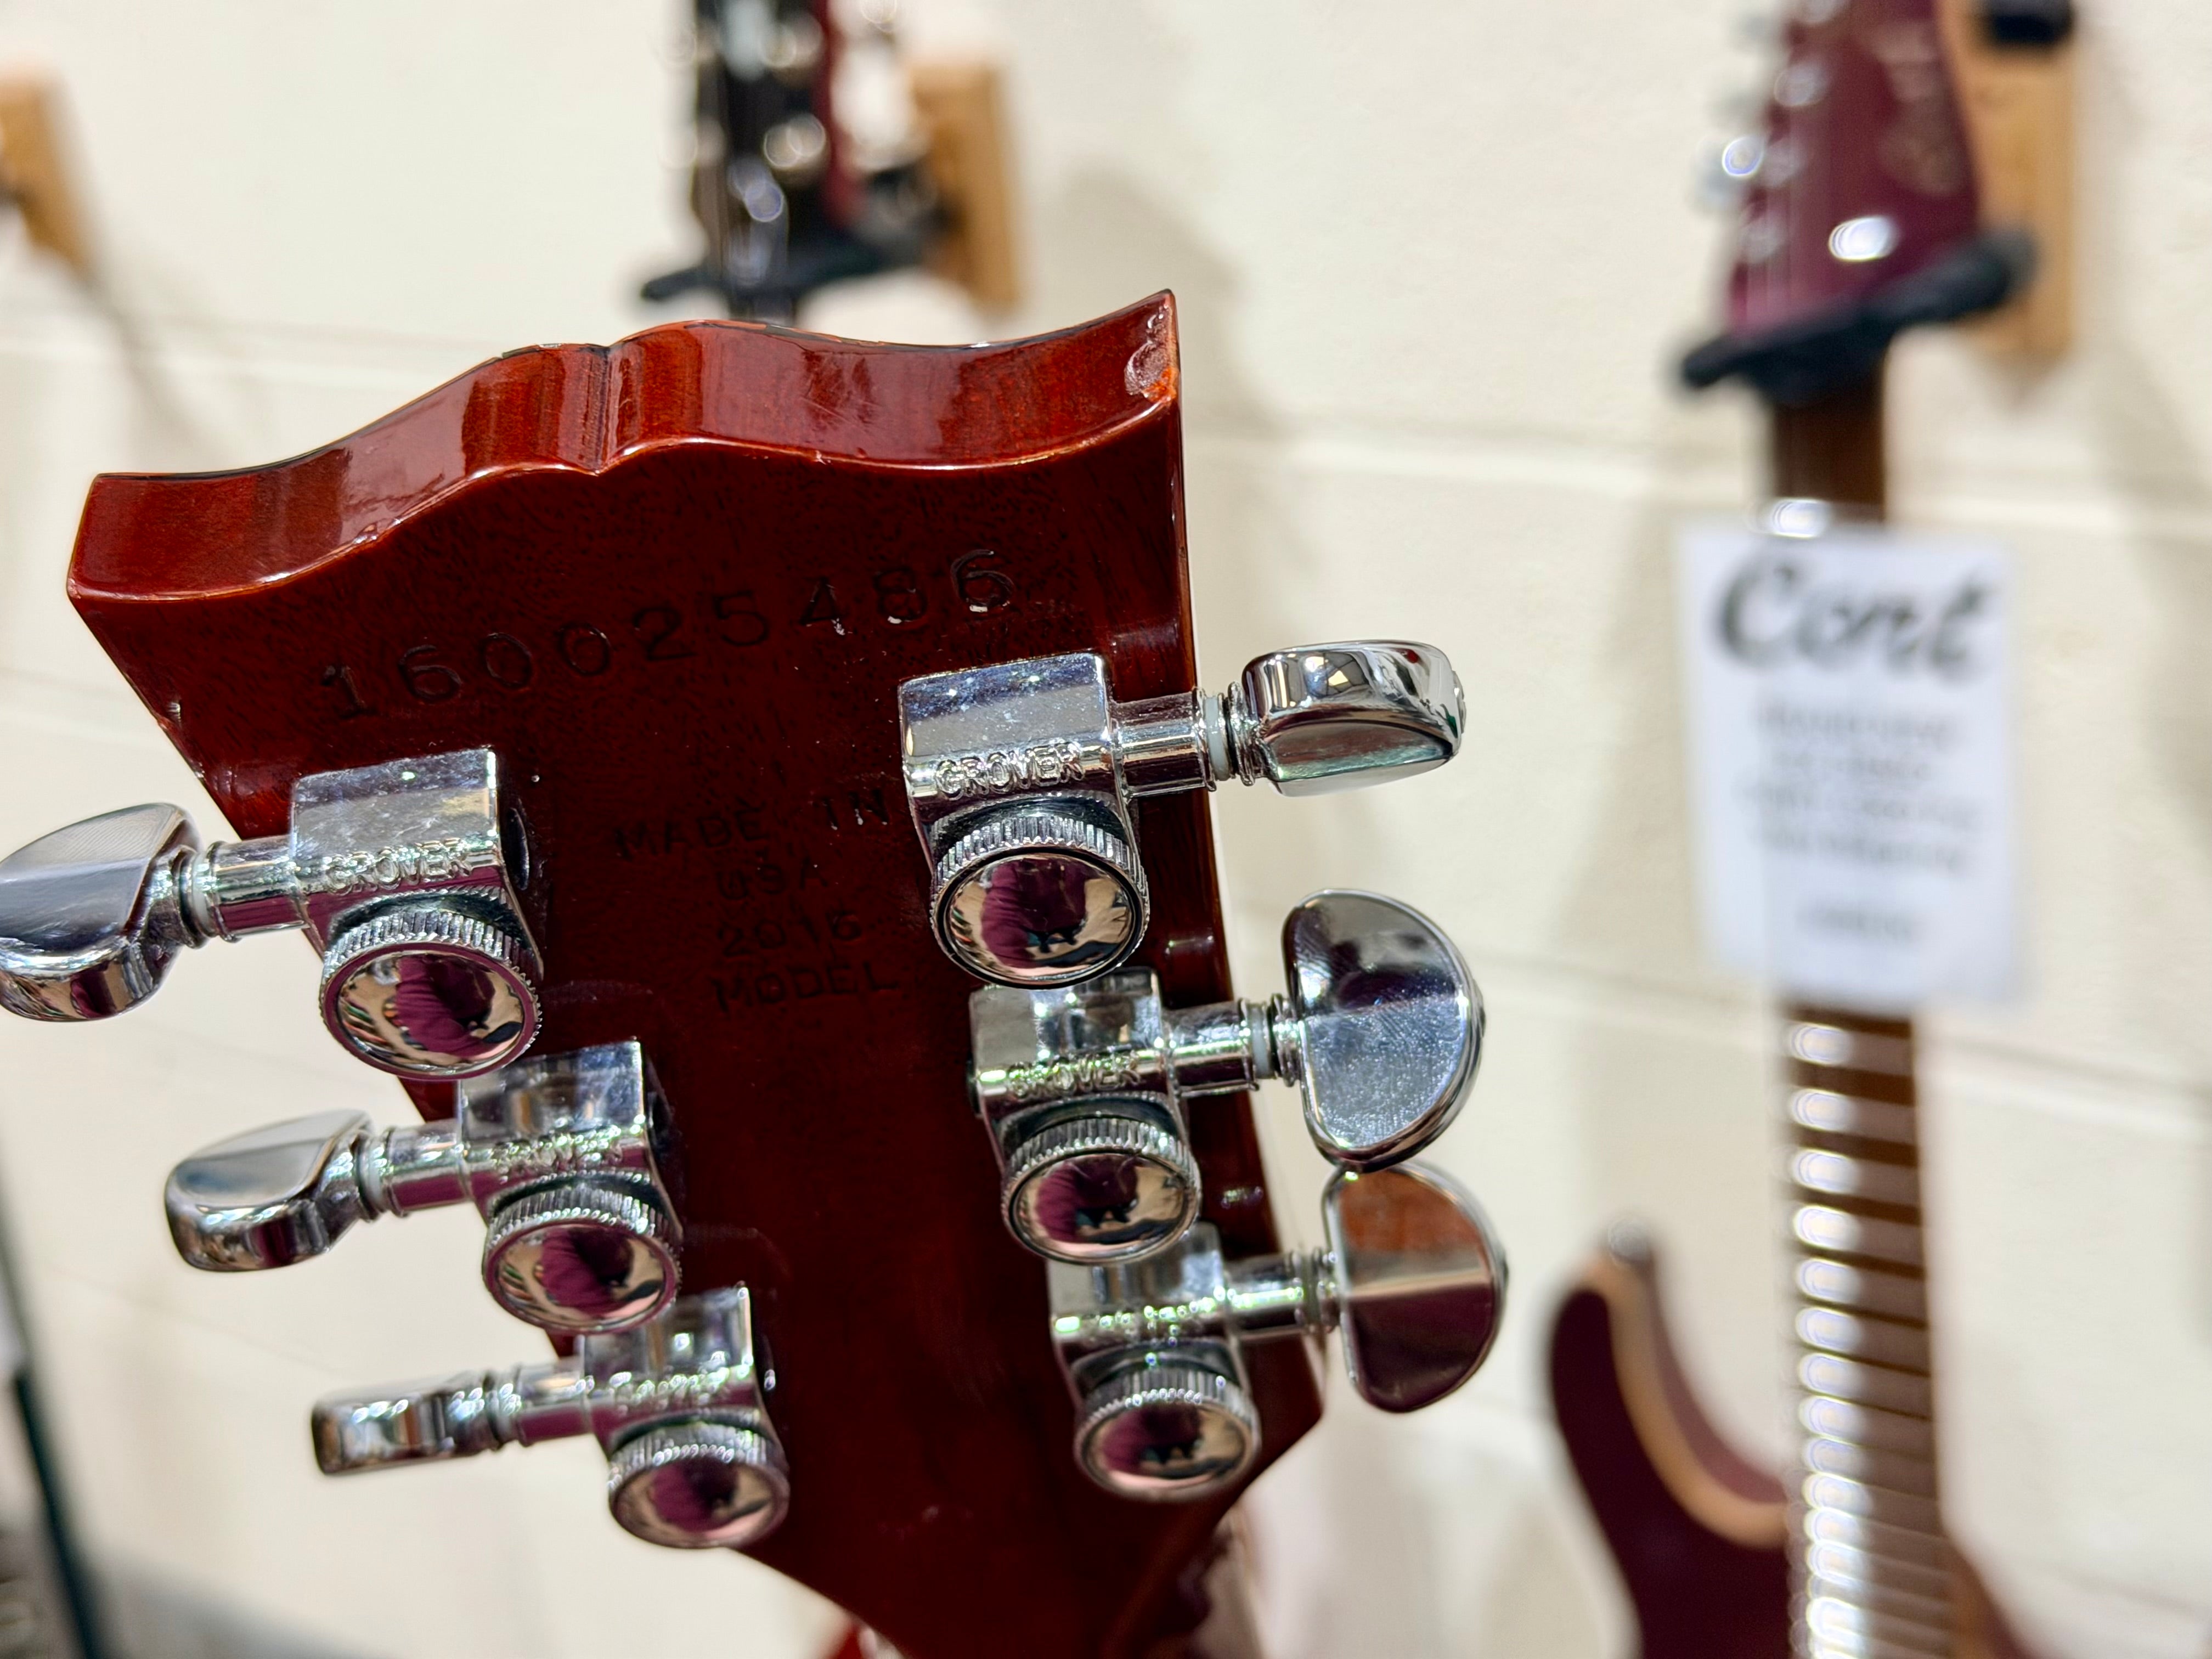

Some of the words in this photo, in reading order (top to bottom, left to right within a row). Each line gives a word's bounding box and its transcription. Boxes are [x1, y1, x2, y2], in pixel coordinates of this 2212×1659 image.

[319, 549, 1015, 721] 160025486
[1713, 551, 1997, 686] Cort
[935, 738, 1085, 802] GROVER
[612, 806, 770, 860] MADE
[821, 787, 891, 831] IN
[327, 837, 474, 896] GROVER
[715, 855, 830, 901] USA
[716, 909, 864, 959] 2016
[710, 959, 902, 1014] MODEL
